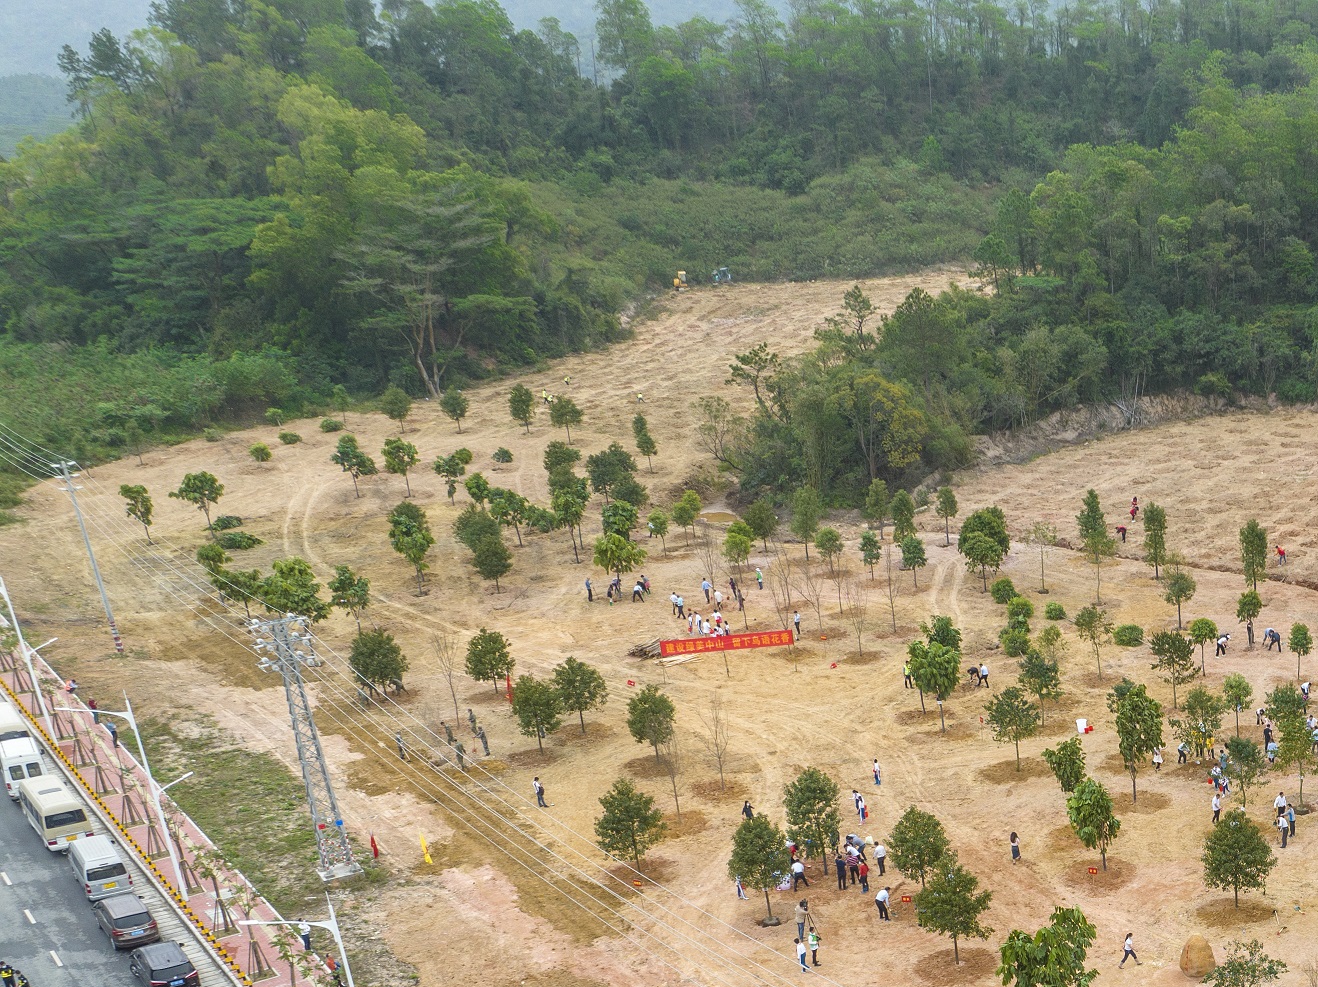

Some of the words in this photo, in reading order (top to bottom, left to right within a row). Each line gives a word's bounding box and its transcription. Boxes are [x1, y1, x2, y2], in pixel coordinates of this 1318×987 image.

[666, 639, 724, 653] 建设绿美中山
[732, 633, 790, 647] 留下鸟语花香
